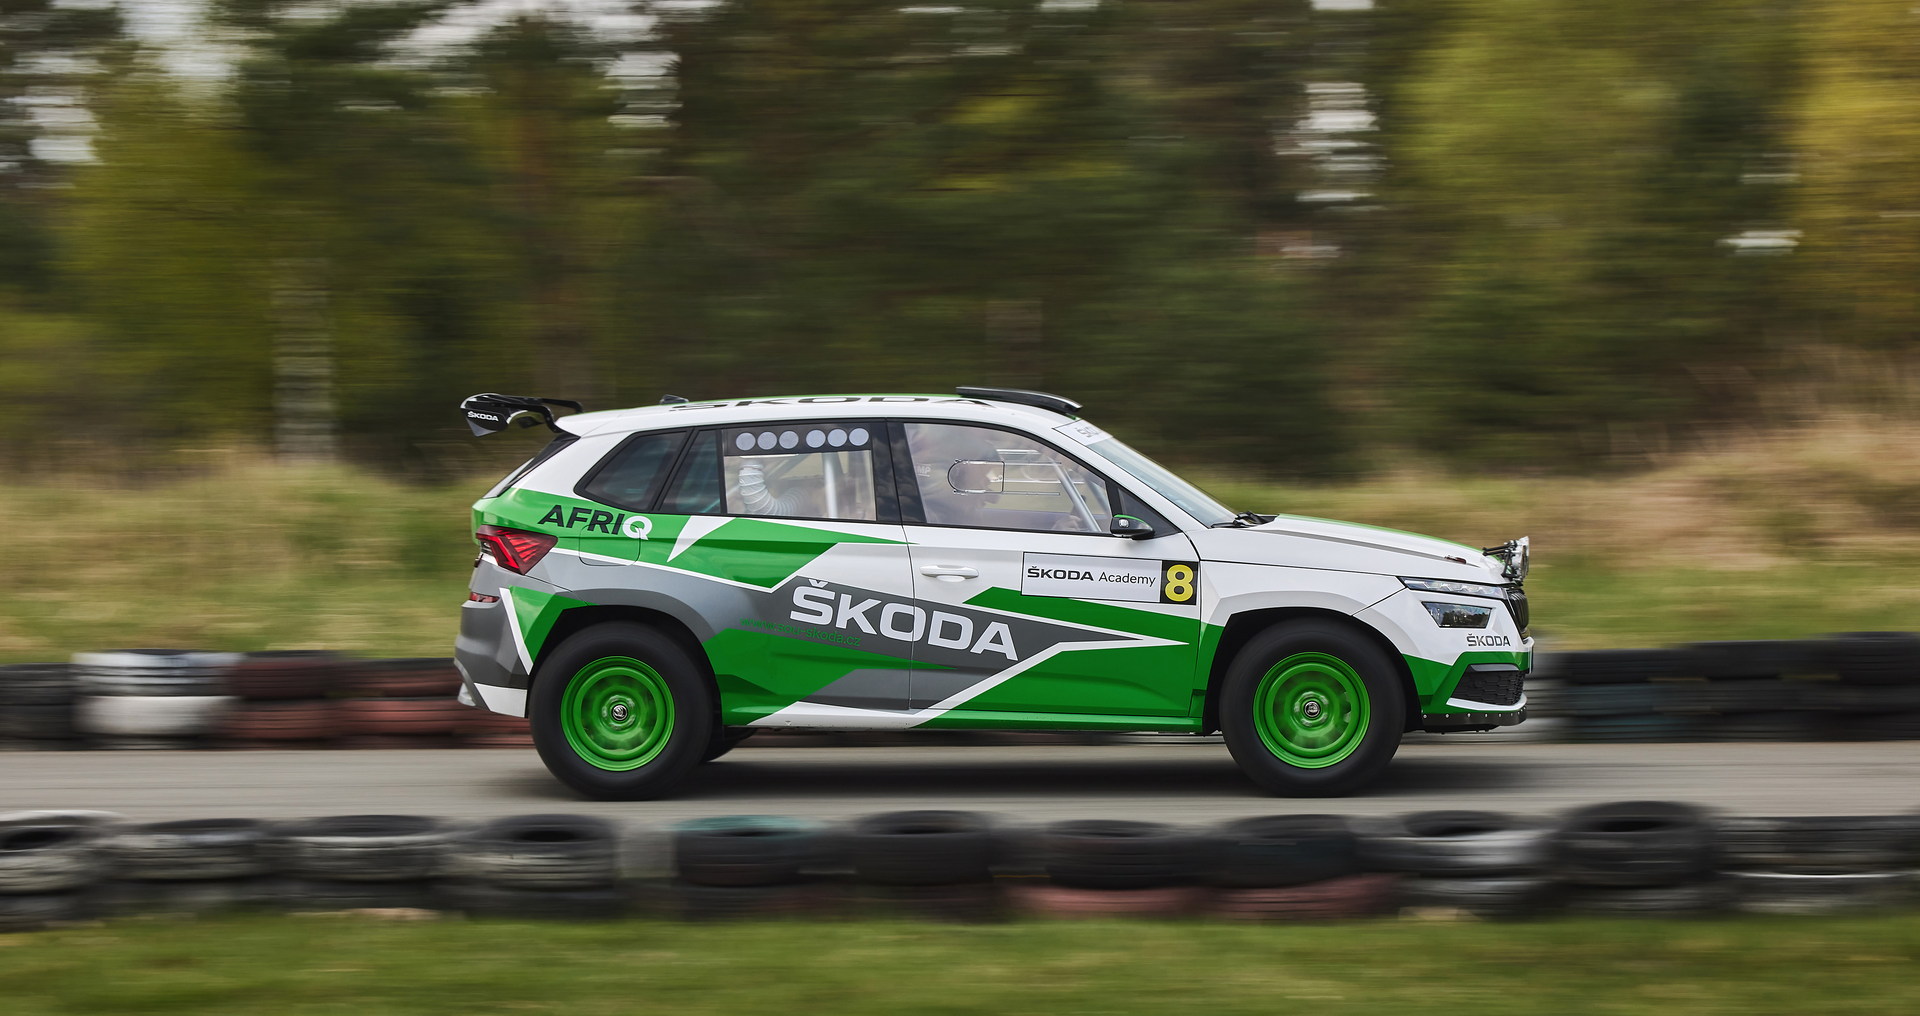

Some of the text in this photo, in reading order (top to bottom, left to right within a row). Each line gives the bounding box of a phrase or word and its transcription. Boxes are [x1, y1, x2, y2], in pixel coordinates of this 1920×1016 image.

[467, 411, 499, 422] ŠKODA
[537, 504, 653, 540] AFRIQ
[1027, 565, 1156, 587] ŠKODA Academy
[1164, 563, 1194, 602] 8
[739, 616, 861, 647] www.sou-skoda.cz
[790, 577, 1019, 661] ŠKODA
[1467, 633, 1511, 647] ŠKODA
